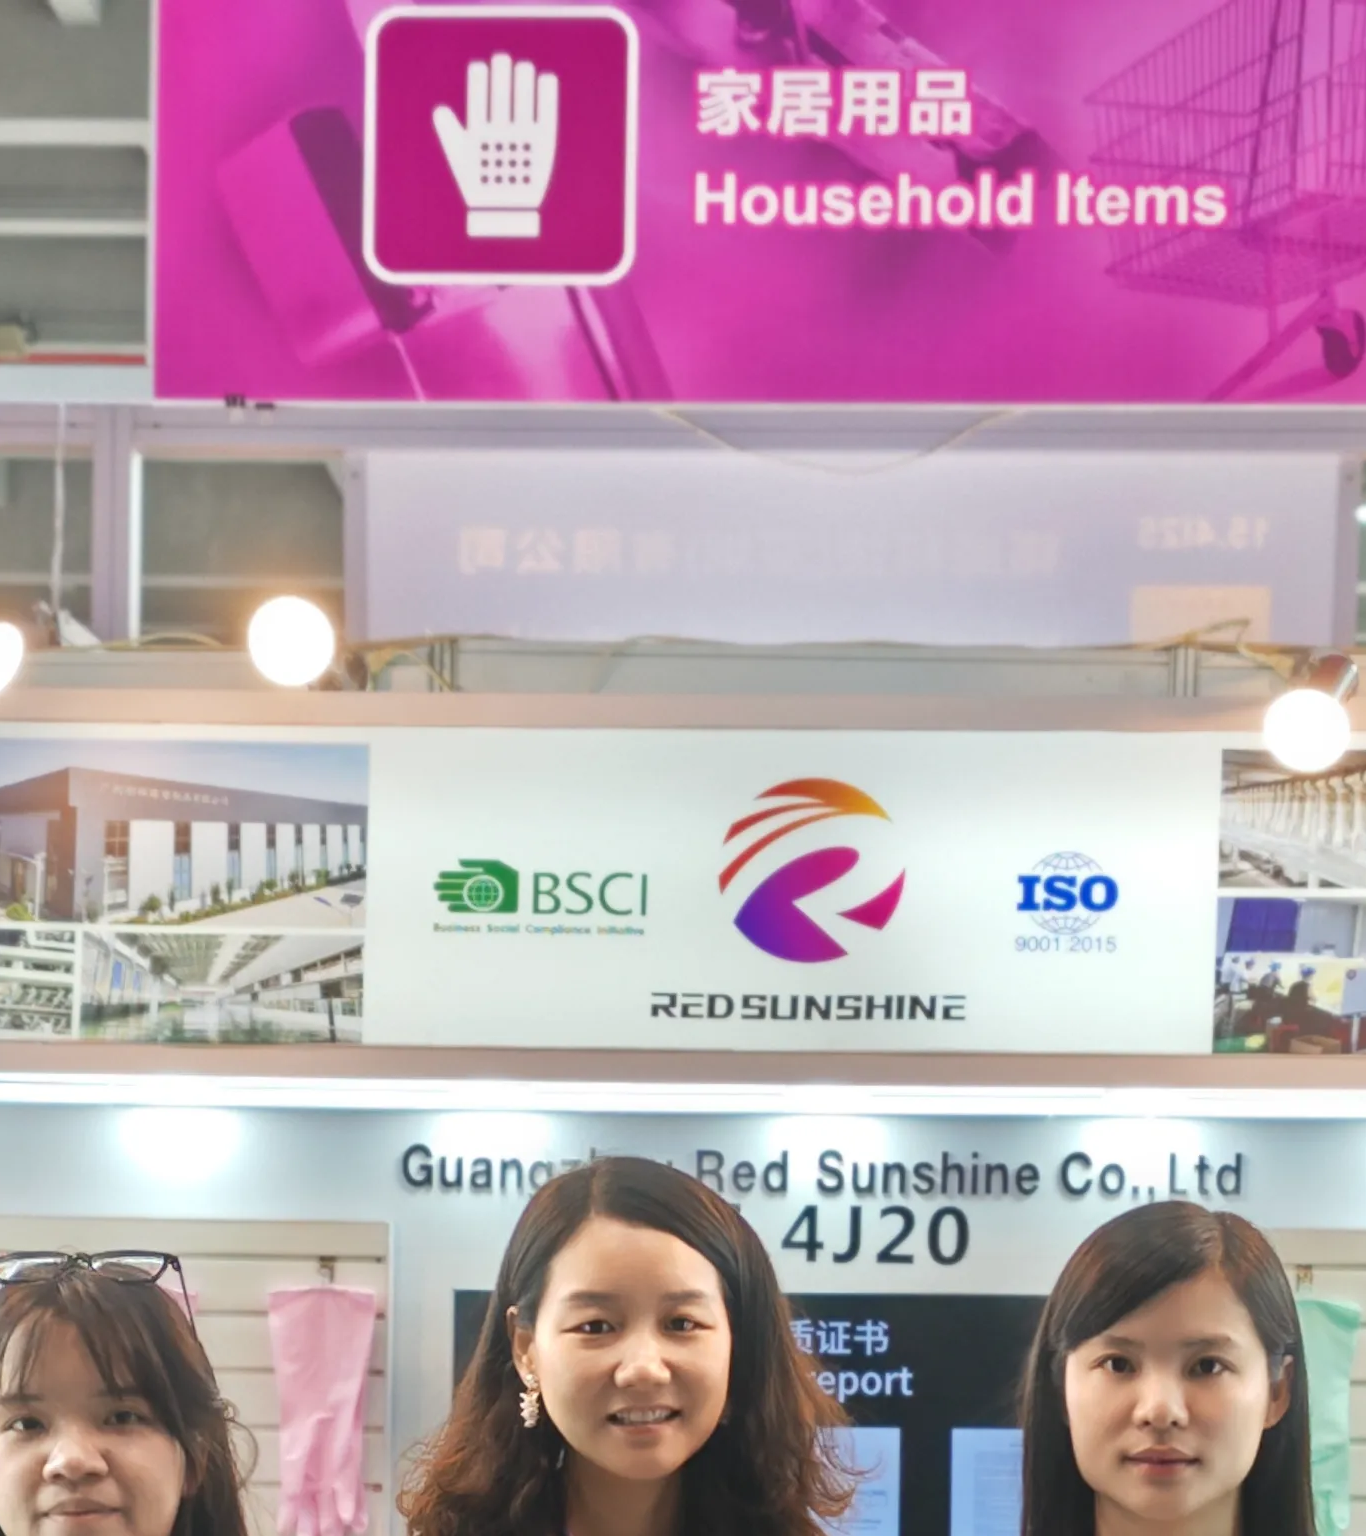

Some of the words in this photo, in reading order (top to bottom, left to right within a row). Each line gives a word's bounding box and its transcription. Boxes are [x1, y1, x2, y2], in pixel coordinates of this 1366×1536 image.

[694, 68, 973, 137] 家居用品
[694, 173, 1034, 227] Household
[1056, 175, 1227, 227] Items
[532, 872, 647, 917] BSCI
[1017, 875, 1119, 912] ISO
[1015, 936, 1060, 953] 9001
[1069, 936, 1117, 953] 2015
[650, 993, 735, 1023] RED
[741, 994, 967, 1023] SUNSHINE
[696, 1150, 788, 1194] Red
[817, 1151, 1040, 1197] Sunshine
[783, 1205, 970, 1266] 4J20
